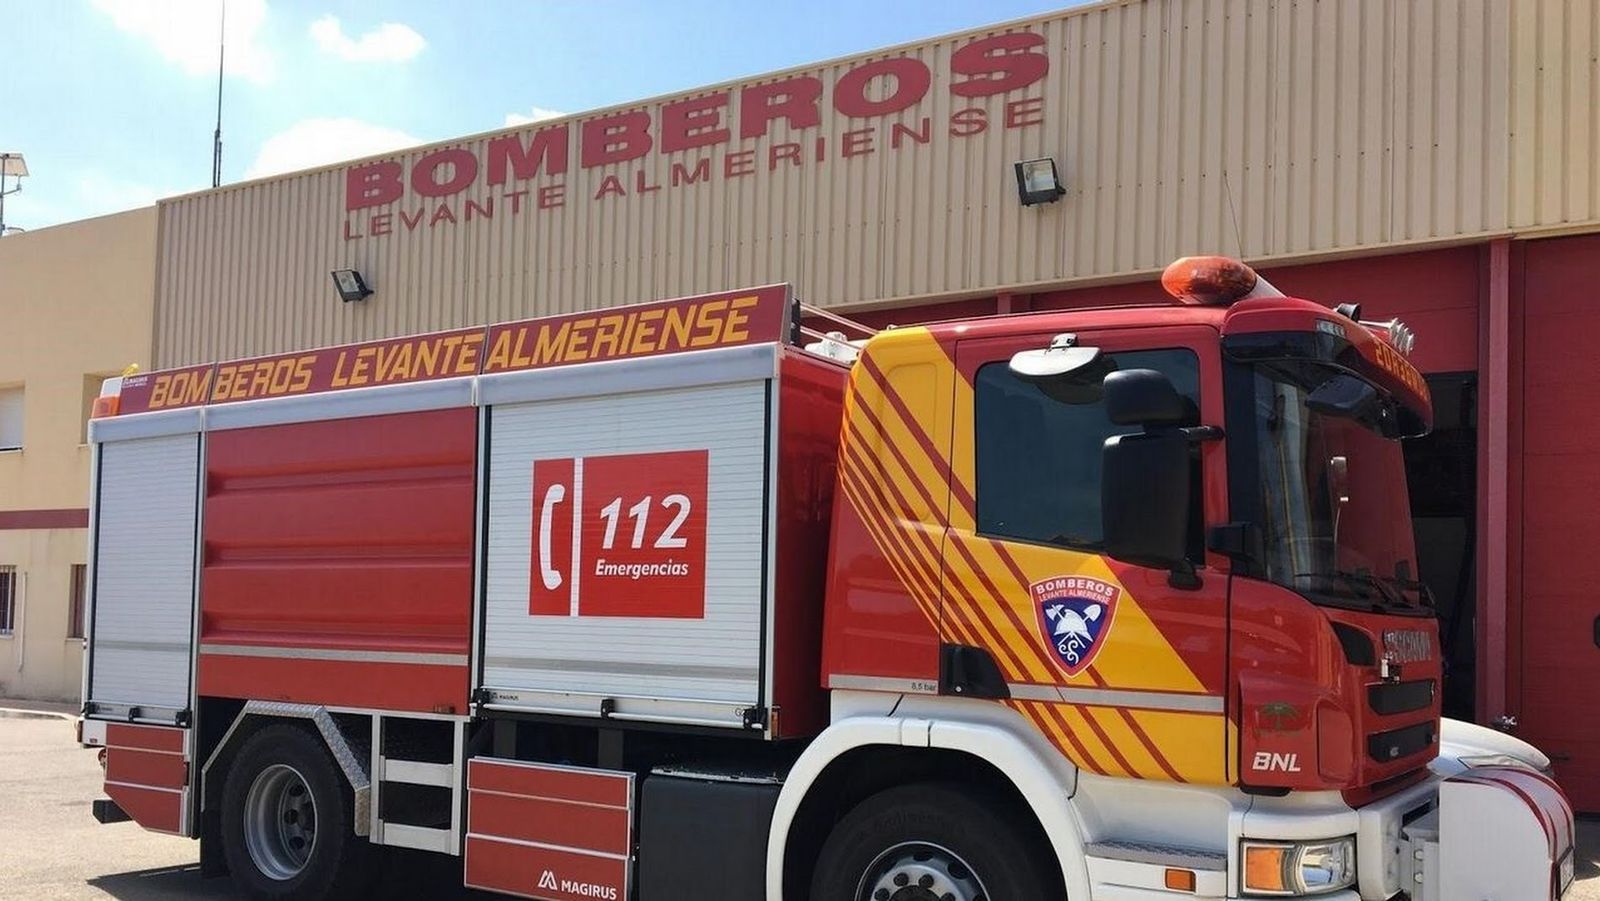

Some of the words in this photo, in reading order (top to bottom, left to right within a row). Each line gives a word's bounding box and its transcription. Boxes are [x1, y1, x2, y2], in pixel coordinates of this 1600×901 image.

[346, 32, 1049, 211] BOMBEROS
[344, 185, 566, 241] LEVANTE
[594, 97, 1044, 200] ALMERIENSE
[149, 356, 317, 408] BOMBEROS
[330, 333, 484, 388] LEVANTE
[485, 296, 758, 370] ALMERIENSE
[600, 494, 691, 549] 112
[595, 559, 689, 579] Emergencias
[1035, 578, 1114, 597] BOMBEROS
[1039, 590, 1067, 602] LEVANTE
[1069, 588, 1112, 605] ALMERIENSE
[924, 682, 937, 691] bar
[1252, 752, 1301, 772] BNL
[561, 880, 617, 900] MAGIRUS
